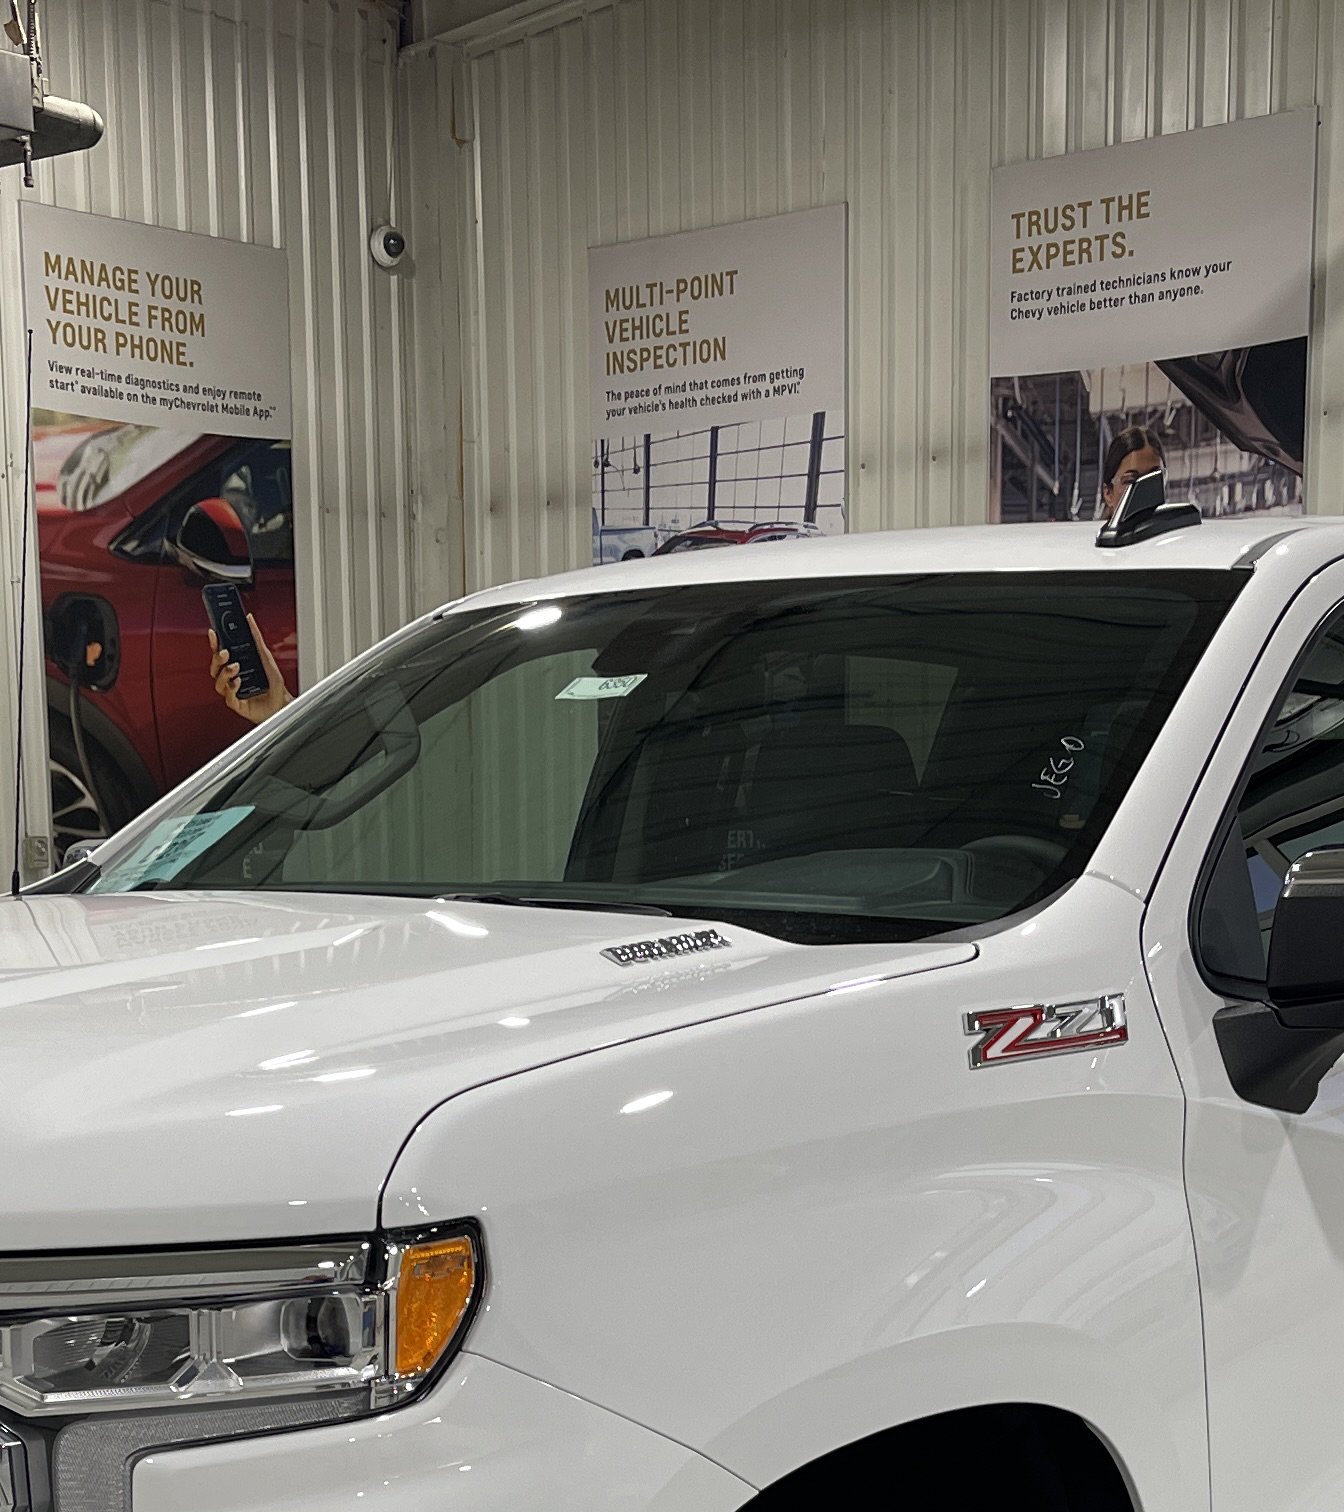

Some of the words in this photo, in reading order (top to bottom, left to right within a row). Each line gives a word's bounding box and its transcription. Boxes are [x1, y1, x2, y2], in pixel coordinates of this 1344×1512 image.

[1011, 200, 1093, 240] TRUST
[1100, 190, 1151, 225] THE
[1011, 231, 1135, 275] EXPERTS.
[44, 251, 140, 294] MANAGE
[146, 272, 203, 305] YOUR
[605, 269, 738, 313] MULTI-POINT
[1010, 287, 1053, 304] Factory
[1056, 279, 1097, 298] trained
[1099, 270, 1167, 292] technicians
[1169, 265, 1201, 281] know
[1204, 260, 1232, 277] your
[44, 285, 140, 327] VEHICLE
[147, 305, 206, 338] FROM
[1010, 305, 1044, 321] Chevy
[1046, 299, 1086, 317] vehicle
[1089, 294, 1125, 311] better
[1128, 290, 1155, 305] than
[1158, 283, 1204, 301] anyone.
[46, 318, 108, 354] YOUR
[115, 331, 195, 368] PHONE.
[604, 309, 690, 344] VEHICLE
[606, 336, 727, 376] INSPECTION
[47, 359, 73, 376] View
[75, 364, 122, 384] real-time
[124, 374, 180, 394] diagnostics
[182, 380, 199, 395] and
[201, 383, 227, 401] enjoy
[228, 387, 262, 402] remote
[80, 383, 124, 402] available
[126, 391, 139, 402] on
[141, 391, 157, 405] the
[159, 395, 220, 414] myChevrolet
[221, 402, 250, 417] Mobile
[606, 390, 622, 402] The
[624, 388, 650, 404] peace
[652, 384, 663, 396] of
[664, 381, 687, 394] mind
[689, 378, 708, 392] that
[710, 376, 741, 390] comes
[743, 372, 767, 386] from
[769, 366, 805, 386] getting
[606, 406, 626, 420] your
[628, 400, 667, 416] vehicle's
[668, 397, 698, 411] health
[699, 392, 738, 408] checked
[740, 388, 763, 402] with
[764, 389, 771, 398] a
[962, 992, 1128, 1070] Z71
